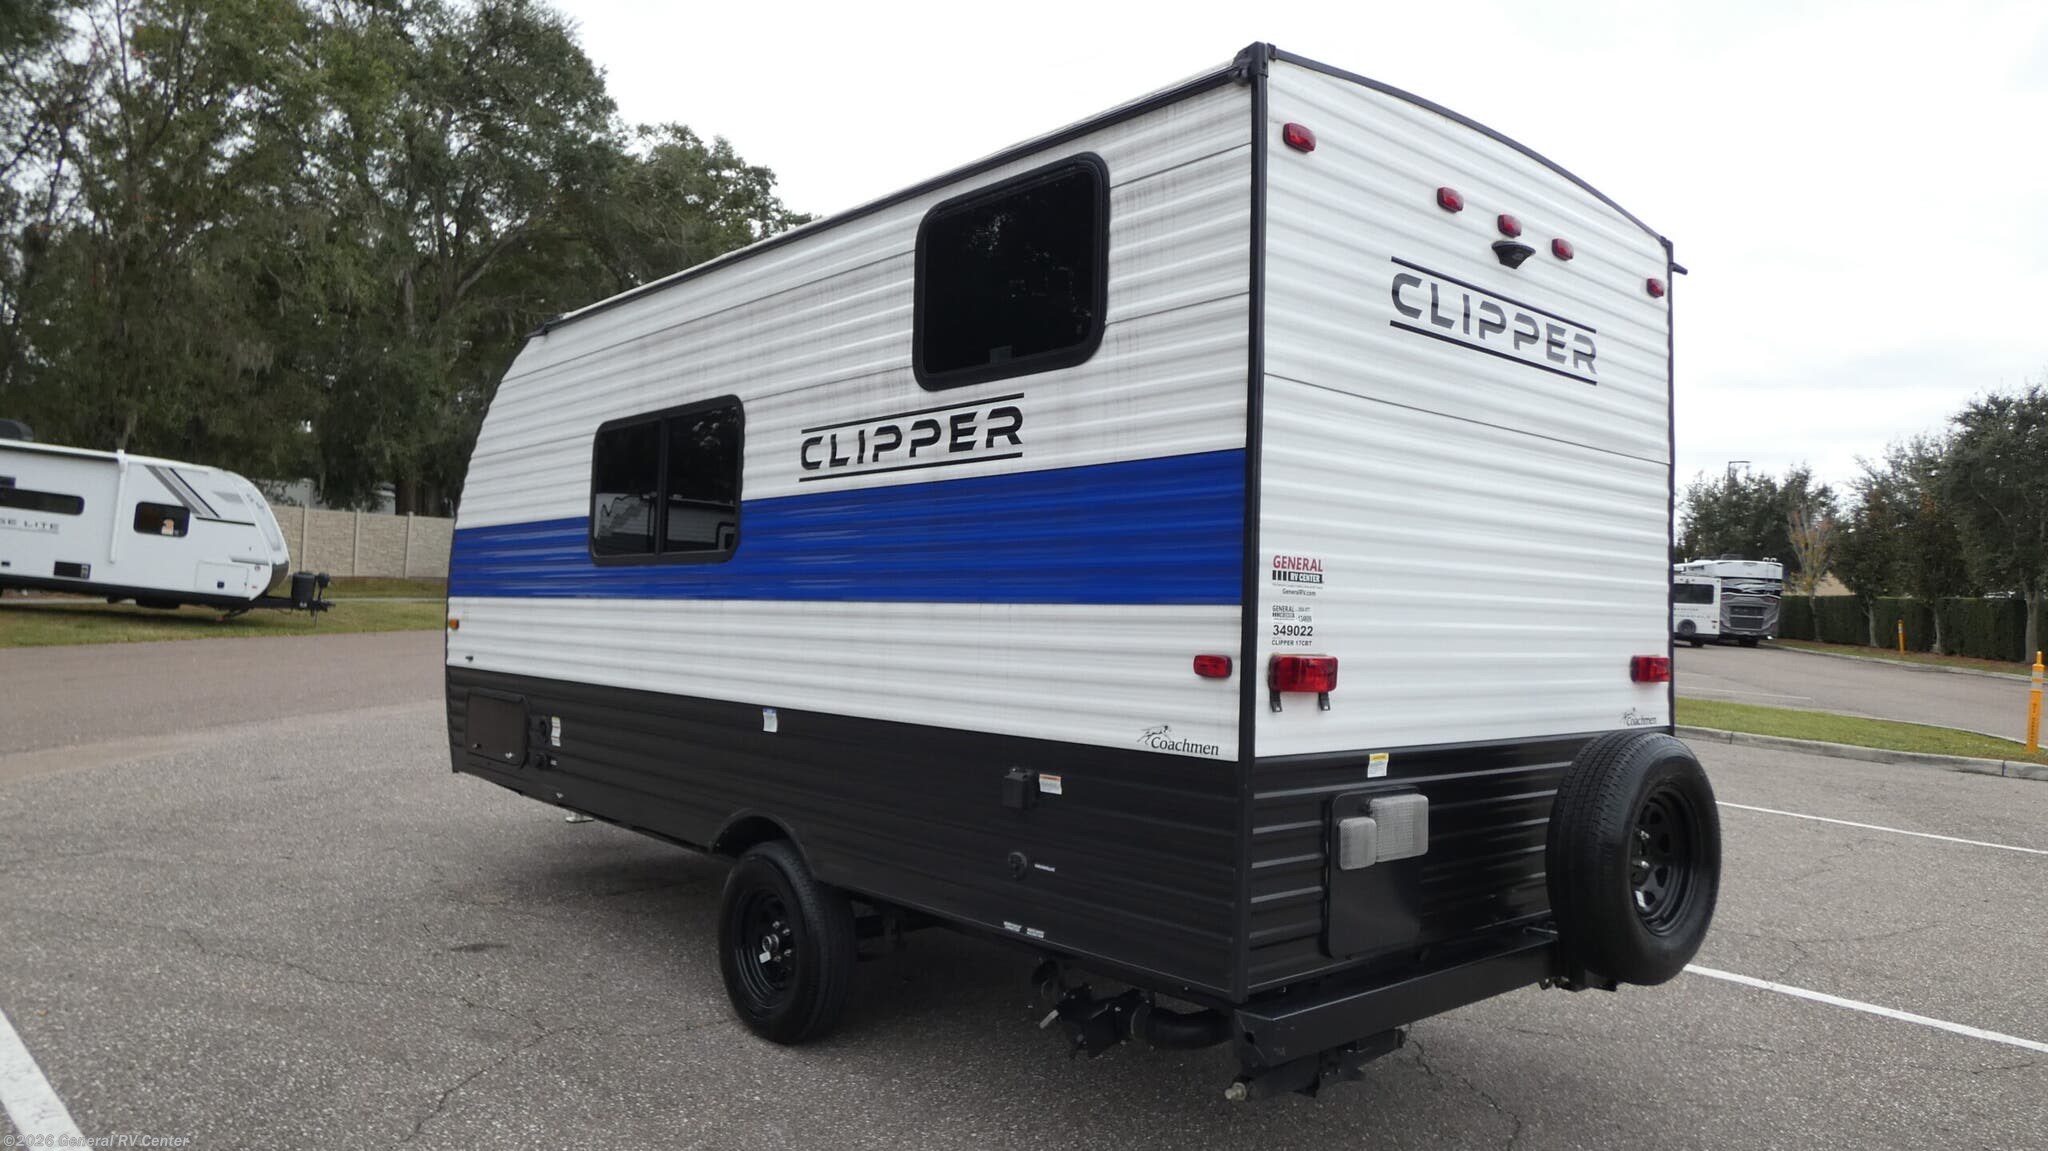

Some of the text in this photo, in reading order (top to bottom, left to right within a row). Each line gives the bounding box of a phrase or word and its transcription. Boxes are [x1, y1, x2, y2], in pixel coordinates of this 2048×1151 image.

[1391, 272, 1598, 375] CLIPPER
[800, 405, 1024, 470] CLIPPER
[1273, 555, 1323, 572] GENERAL
[1299, 573, 1321, 583] CENTER
[1273, 625, 1313, 637] 349022
[1151, 737, 1219, 755] Coachmen
